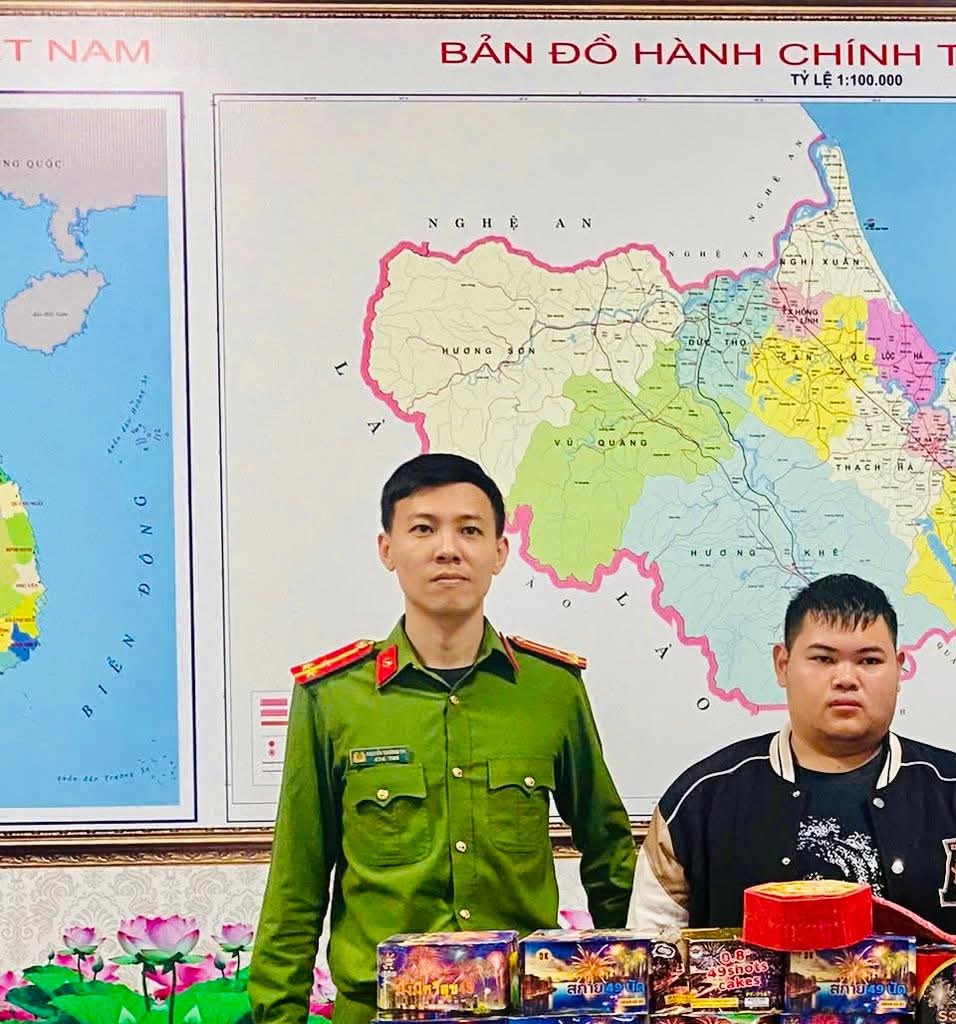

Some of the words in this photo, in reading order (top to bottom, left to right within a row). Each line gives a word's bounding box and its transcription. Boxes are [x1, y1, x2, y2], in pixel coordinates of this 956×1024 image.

[48, 40, 151, 63] NAM
[440, 34, 533, 65] BẢN
[548, 33, 617, 64] ĐỒ
[634, 37, 762, 65] HÀNH
[778, 38, 921, 66] CHÍNH
[790, 71, 811, 86] TỶ
[814, 71, 832, 88] LỆ
[837, 74, 903, 87] 1:100.000
[26, 156, 63, 169] QUỐC
[428, 215, 519, 230] NGHỆ
[555, 217, 593, 229] AN
[780, 258, 814, 266] NGHI
[823, 257, 860, 266] XUÂN
[442, 347, 492, 355] HƯƠNG
[508, 346, 536, 355] SƠN
[554, 438, 574, 447] VŨ
[598, 439, 648, 448] QUANG
[836, 464, 881, 474] THẠCH
[133, 494, 155, 597] ĐÔNG
[691, 549, 756, 557] HƯƠNG
[707, 959, 769, 979] 49shots
[719, 976, 761, 992] cakes
